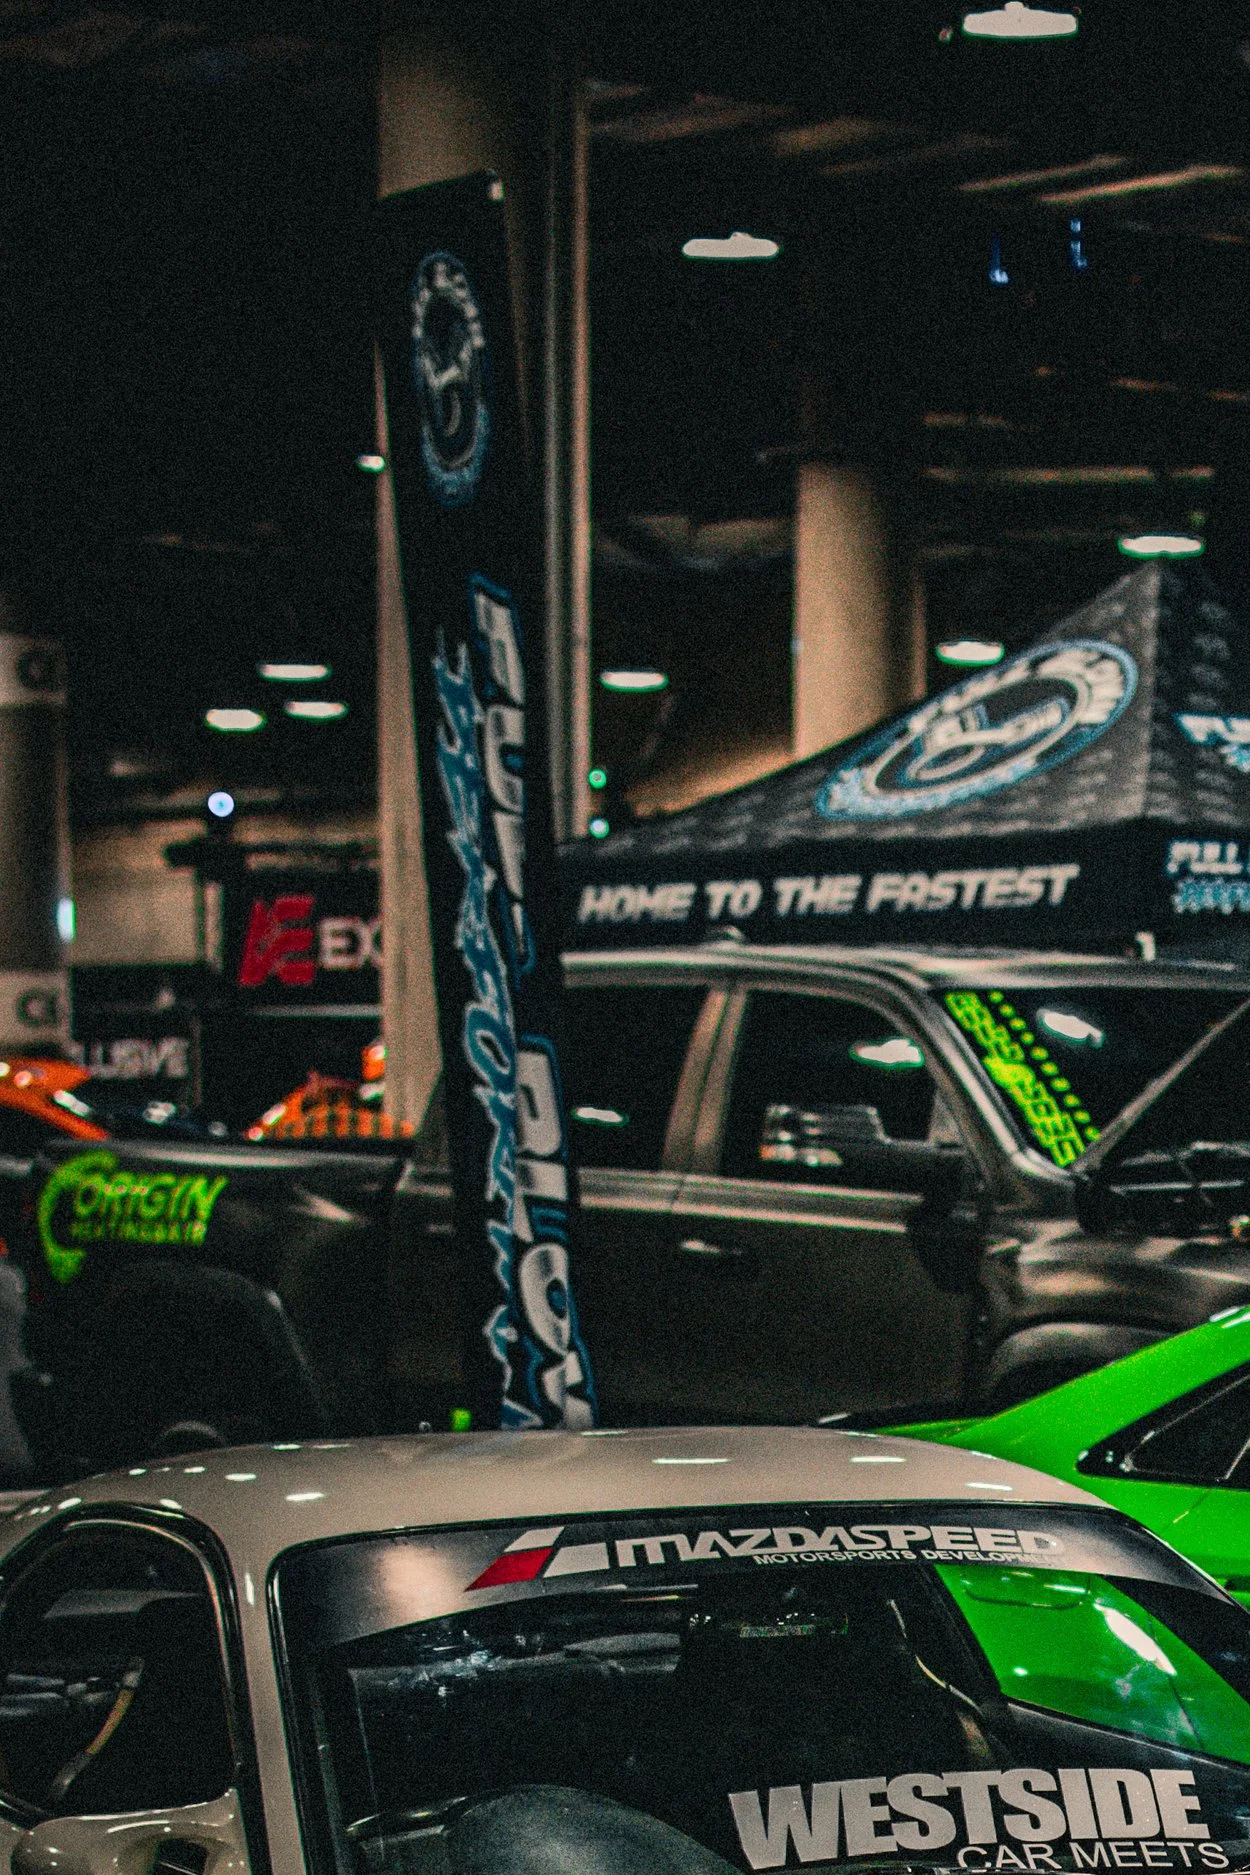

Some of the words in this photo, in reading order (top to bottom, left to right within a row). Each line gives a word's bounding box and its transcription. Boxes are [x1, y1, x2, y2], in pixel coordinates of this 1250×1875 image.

[1167, 842, 1244, 874] FULL
[576, 882, 697, 923] HOME
[704, 878, 763, 919] TO
[773, 873, 864, 916] THE
[866, 863, 1082, 912] FASTEST
[74, 1171, 230, 1222] ORIGIN
[616, 1525, 1065, 1567] MAZDASPEED
[753, 1549, 917, 1566] MOTORSPORTS
[728, 1768, 1212, 1870] WESTSIDE
[956, 1842, 1063, 1870] CAR
[1071, 1840, 1229, 1869] MEETS
